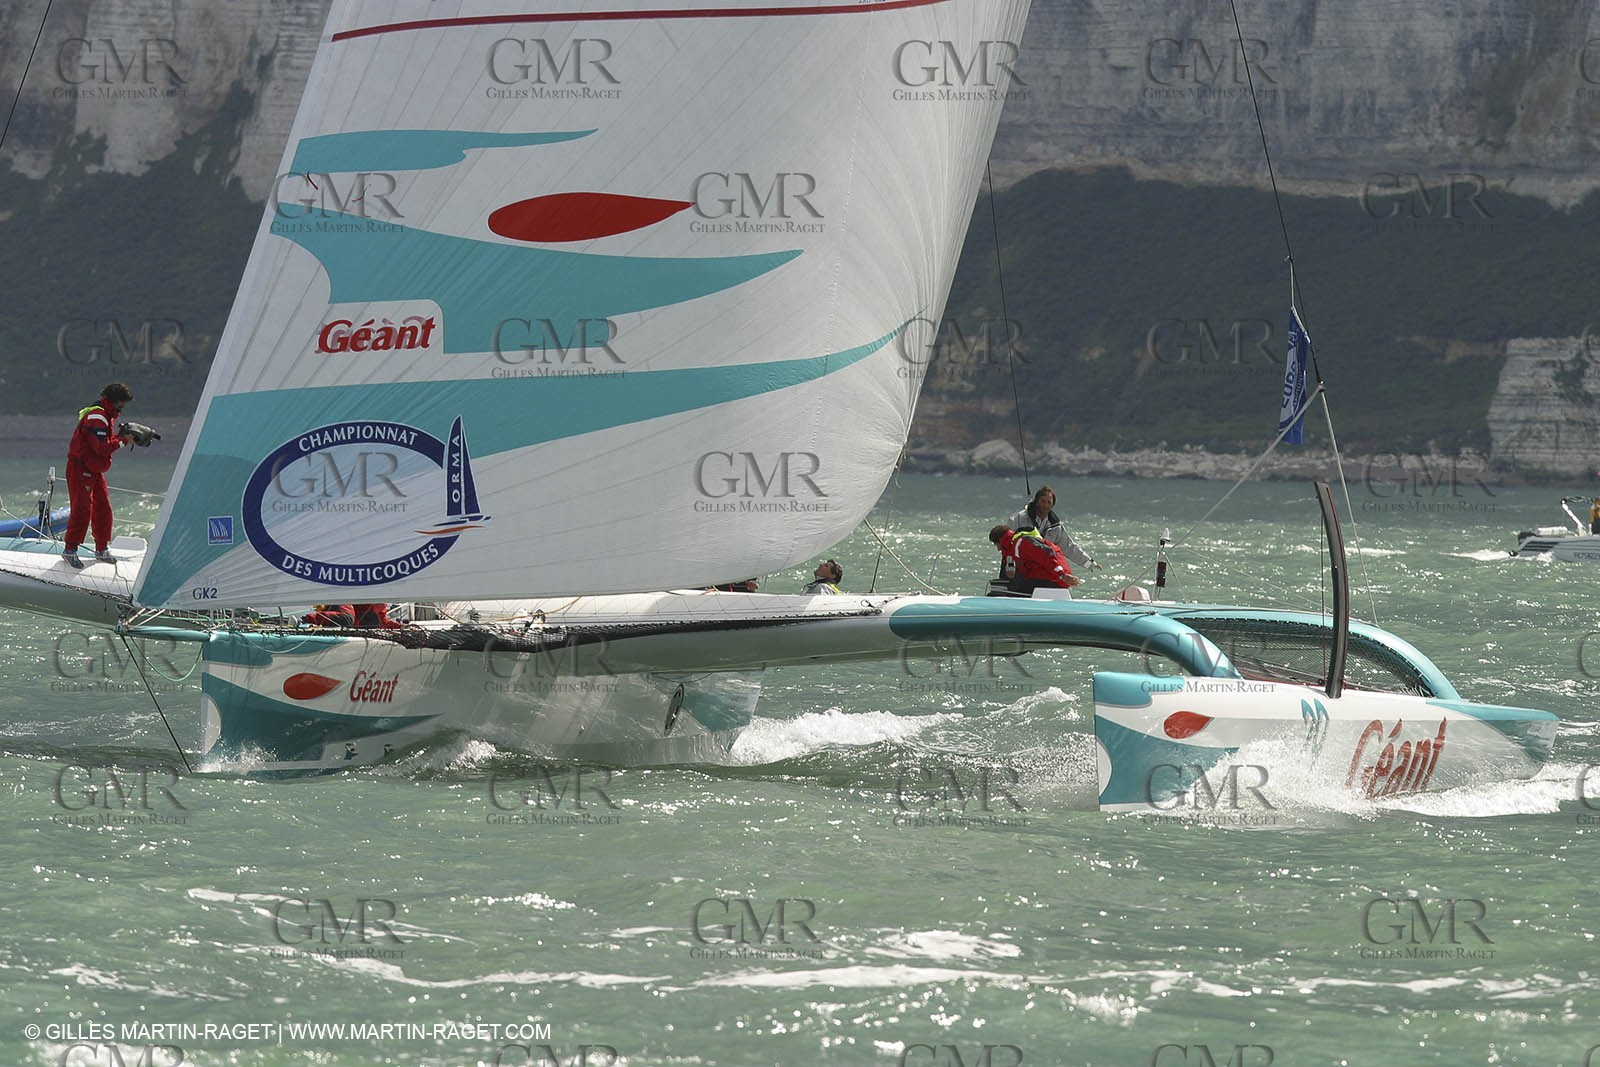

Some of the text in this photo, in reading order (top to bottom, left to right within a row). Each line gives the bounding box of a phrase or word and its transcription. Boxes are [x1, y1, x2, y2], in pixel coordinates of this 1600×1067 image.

[318, 316, 436, 353] Géant
[299, 425, 418, 452] CHAMPIONNAT
[452, 435, 461, 503] ORMA
[282, 543, 439, 583] DES MULTICOQUES
[192, 587, 218, 600] GK2
[349, 671, 399, 703] Géant
